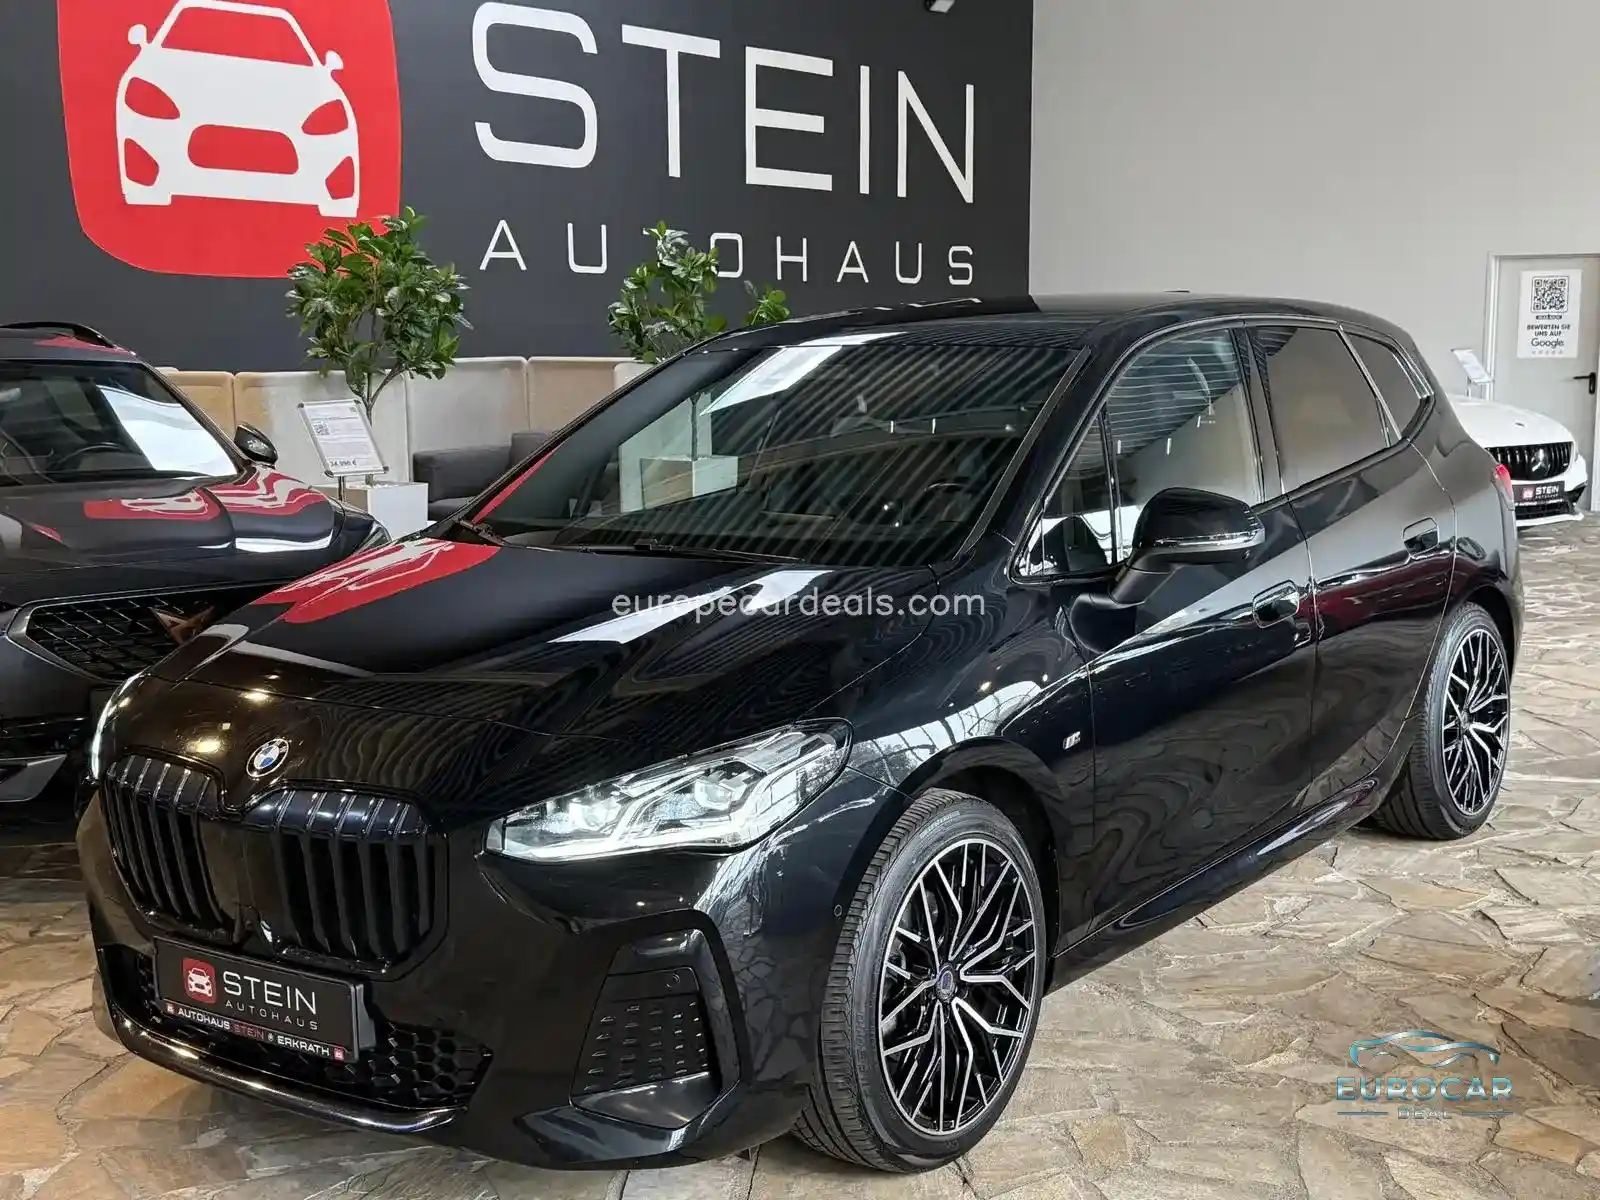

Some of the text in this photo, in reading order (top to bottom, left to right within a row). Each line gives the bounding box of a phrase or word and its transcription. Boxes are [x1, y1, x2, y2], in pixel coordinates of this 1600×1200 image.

[472, 1, 975, 204] STEIN
[479, 219, 974, 286] AUOHAUS
[1531, 338, 1565, 349] Google
[1535, 485, 1559, 495] STEIN
[222, 970, 317, 1015] STEIN
[225, 999, 318, 1031] AUTOHAUS
[177, 1007, 331, 1057] AUTOHAUS STEIN ERKRATH
